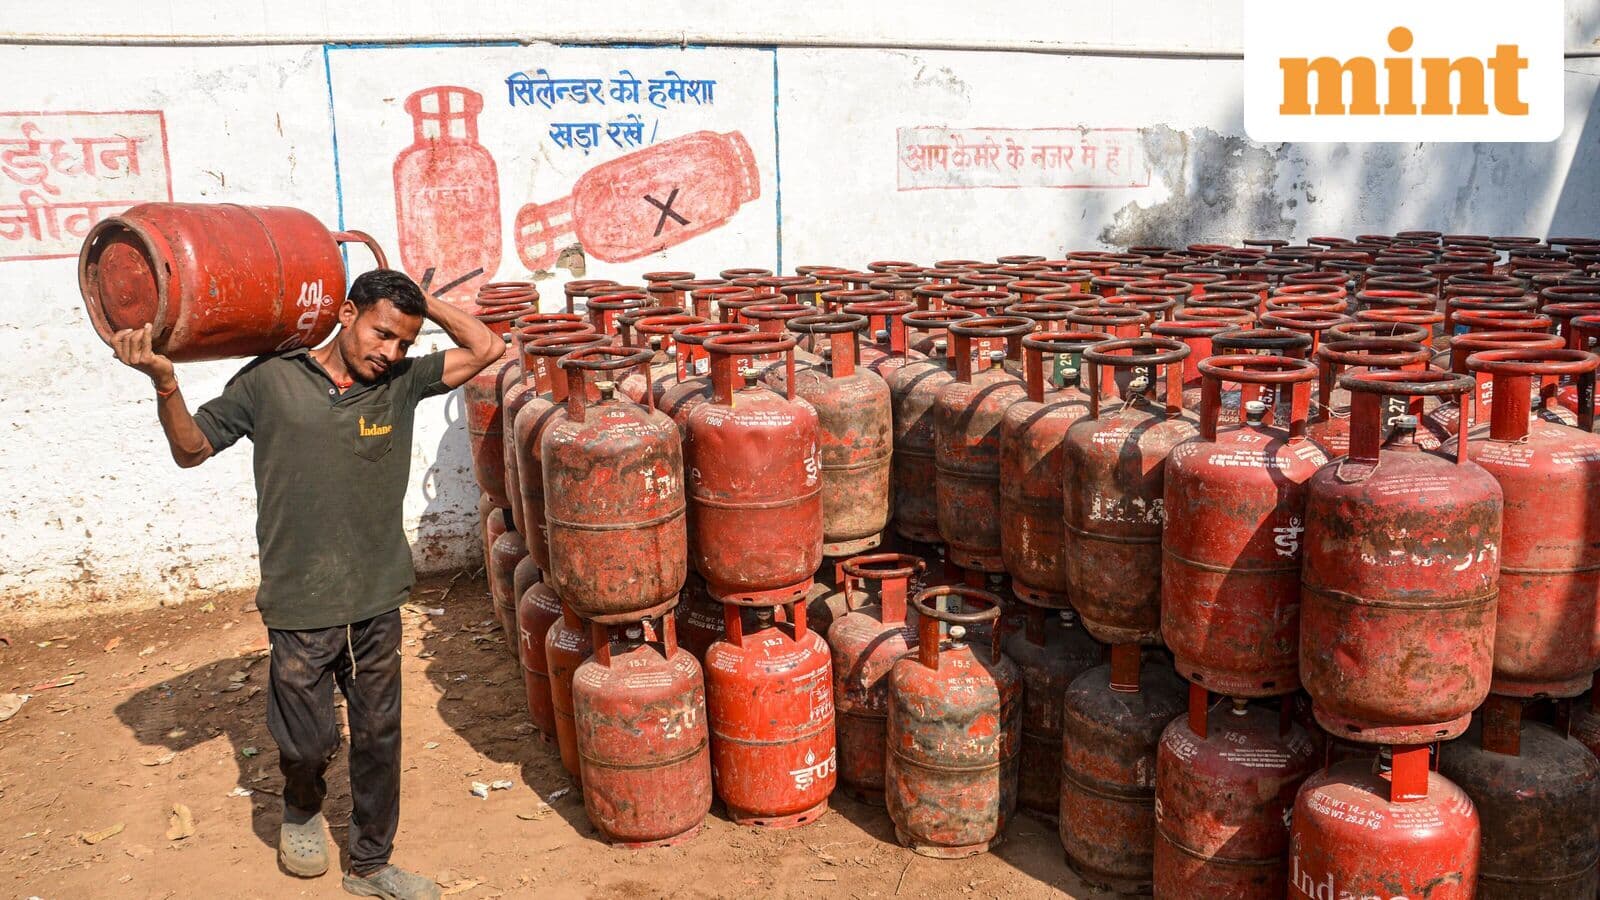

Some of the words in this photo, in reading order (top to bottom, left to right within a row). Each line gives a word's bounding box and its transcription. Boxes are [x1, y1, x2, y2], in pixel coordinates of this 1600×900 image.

[505, 69, 604, 109] सिलेन्डर
[609, 70, 642, 104] को
[647, 71, 716, 109] हमेशा
[1481, 381, 1493, 406] 15.8
[359, 417, 393, 436] Indane
[1236, 433, 1261, 443] 15.7
[762, 637, 783, 647] 15.7
[1224, 731, 1247, 744] 15.6
[1307, 798, 1331, 815] GROSS
[1344, 814, 1365, 825] 29.8
